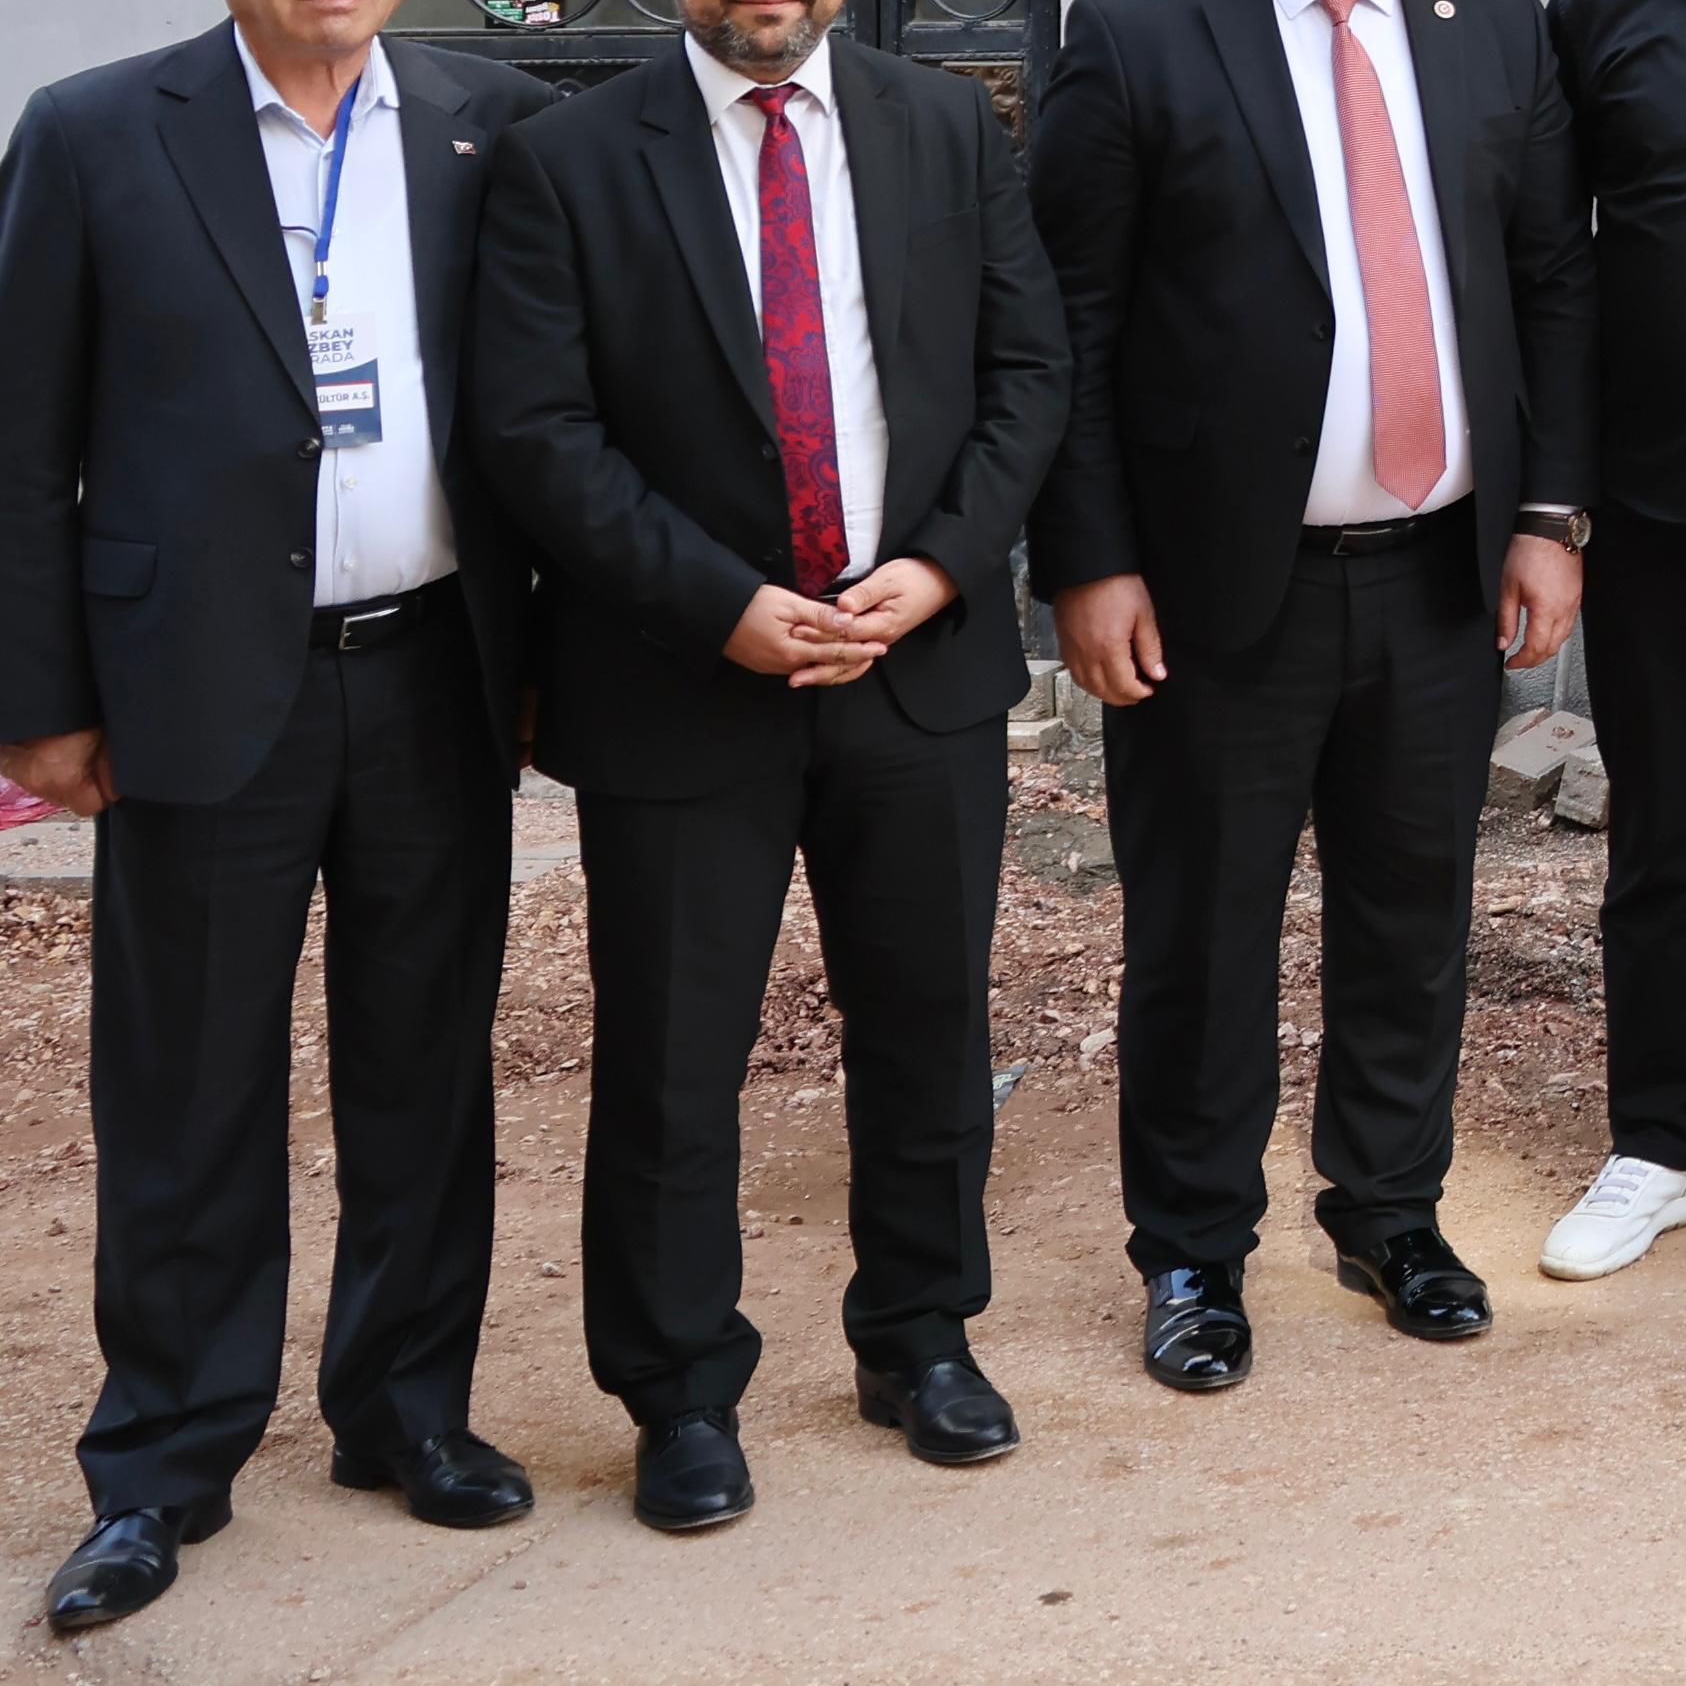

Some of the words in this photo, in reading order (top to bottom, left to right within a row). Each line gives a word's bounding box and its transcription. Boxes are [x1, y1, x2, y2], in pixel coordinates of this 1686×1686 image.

[308, 328, 353, 341] SKAN
[308, 340, 353, 353] ZBEY
[311, 353, 354, 363] RADA
[319, 393, 349, 403] ÜLTÜR
